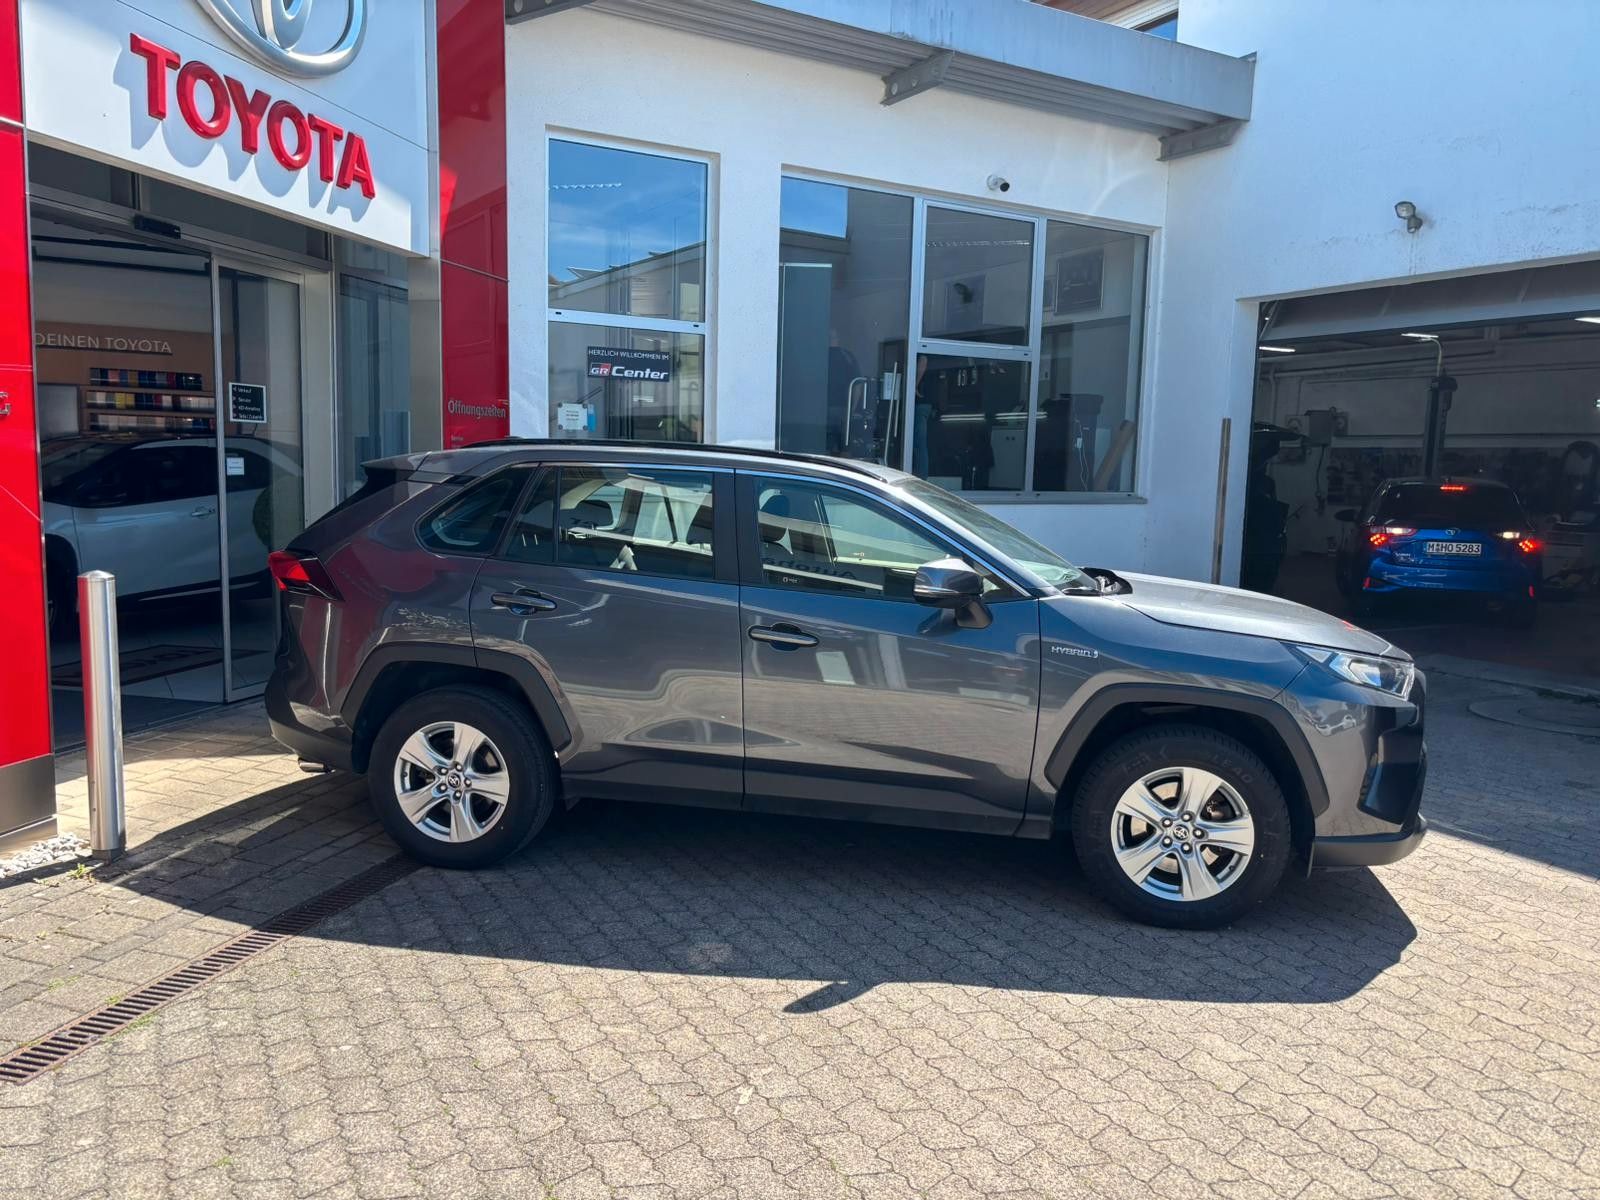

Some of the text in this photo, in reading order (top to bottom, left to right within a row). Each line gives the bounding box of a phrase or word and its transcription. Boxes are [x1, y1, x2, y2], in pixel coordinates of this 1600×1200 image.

[130, 32, 375, 199] TOYOTA
[34, 332, 172, 353] DEINEN TOYOTA
[588, 349, 619, 358] HERZLICH
[620, 351, 661, 360] WILLKOMMEN
[591, 366, 669, 380] GR Center
[447, 398, 506, 419] Öffnungszeiten
[1455, 544, 1481, 554] 5283
[1051, 646, 1092, 657] HYBRID
